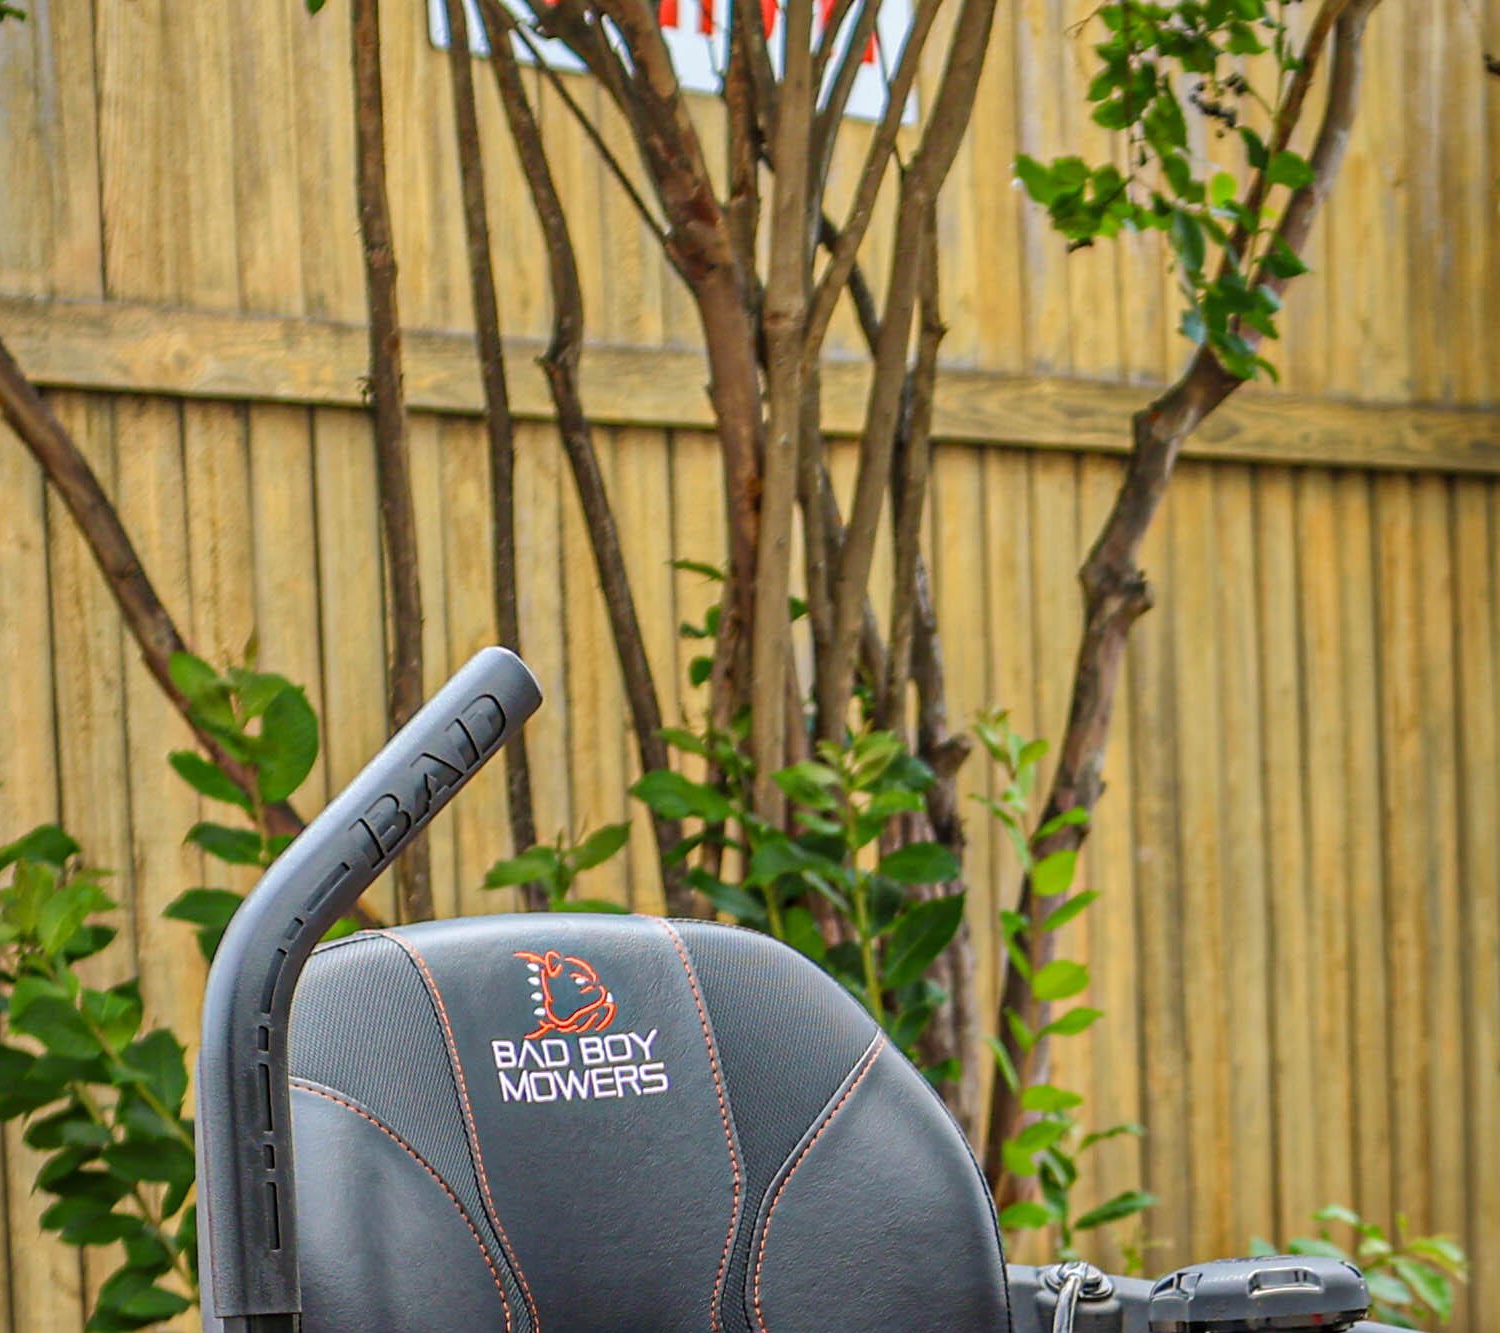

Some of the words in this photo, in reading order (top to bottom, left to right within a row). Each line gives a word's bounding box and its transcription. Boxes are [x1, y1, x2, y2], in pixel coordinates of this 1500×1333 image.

[348, 694, 506, 869] BAD
[492, 1038, 570, 1068] BAD
[578, 1029, 658, 1066] BOY
[498, 1062, 669, 1102] MOWERS
